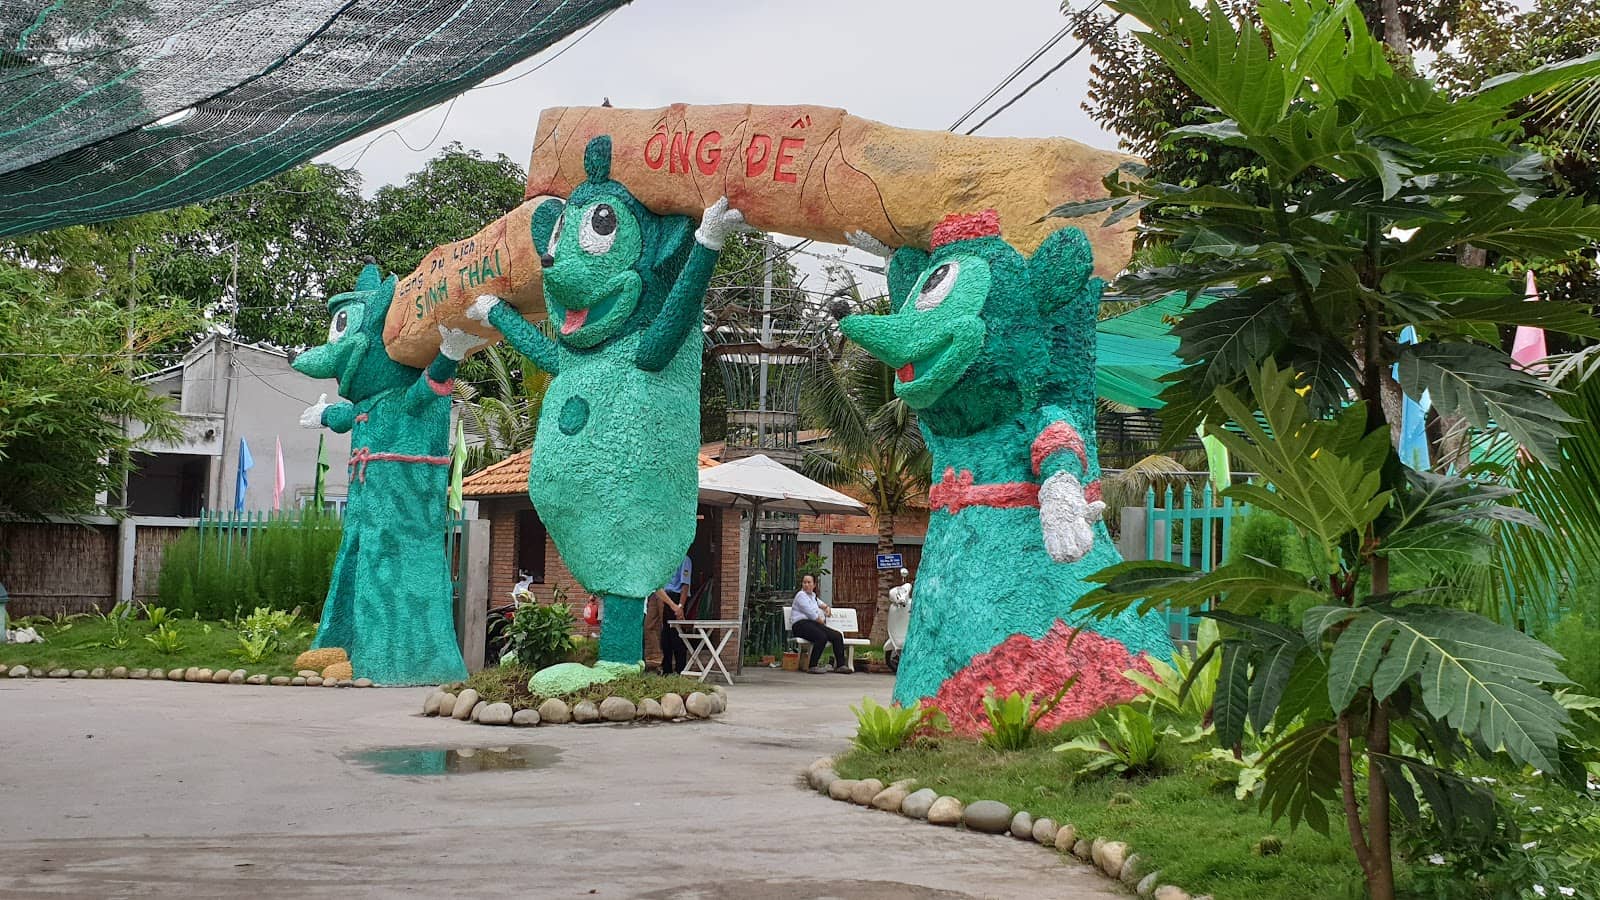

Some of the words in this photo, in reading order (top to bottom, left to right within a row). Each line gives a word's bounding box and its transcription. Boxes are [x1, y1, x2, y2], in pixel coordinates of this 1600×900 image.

[644, 124, 722, 176] ÔNG
[745, 115, 812, 183] ĐỀ
[415, 277, 449, 319] SINH
[459, 245, 501, 291] THÁI
